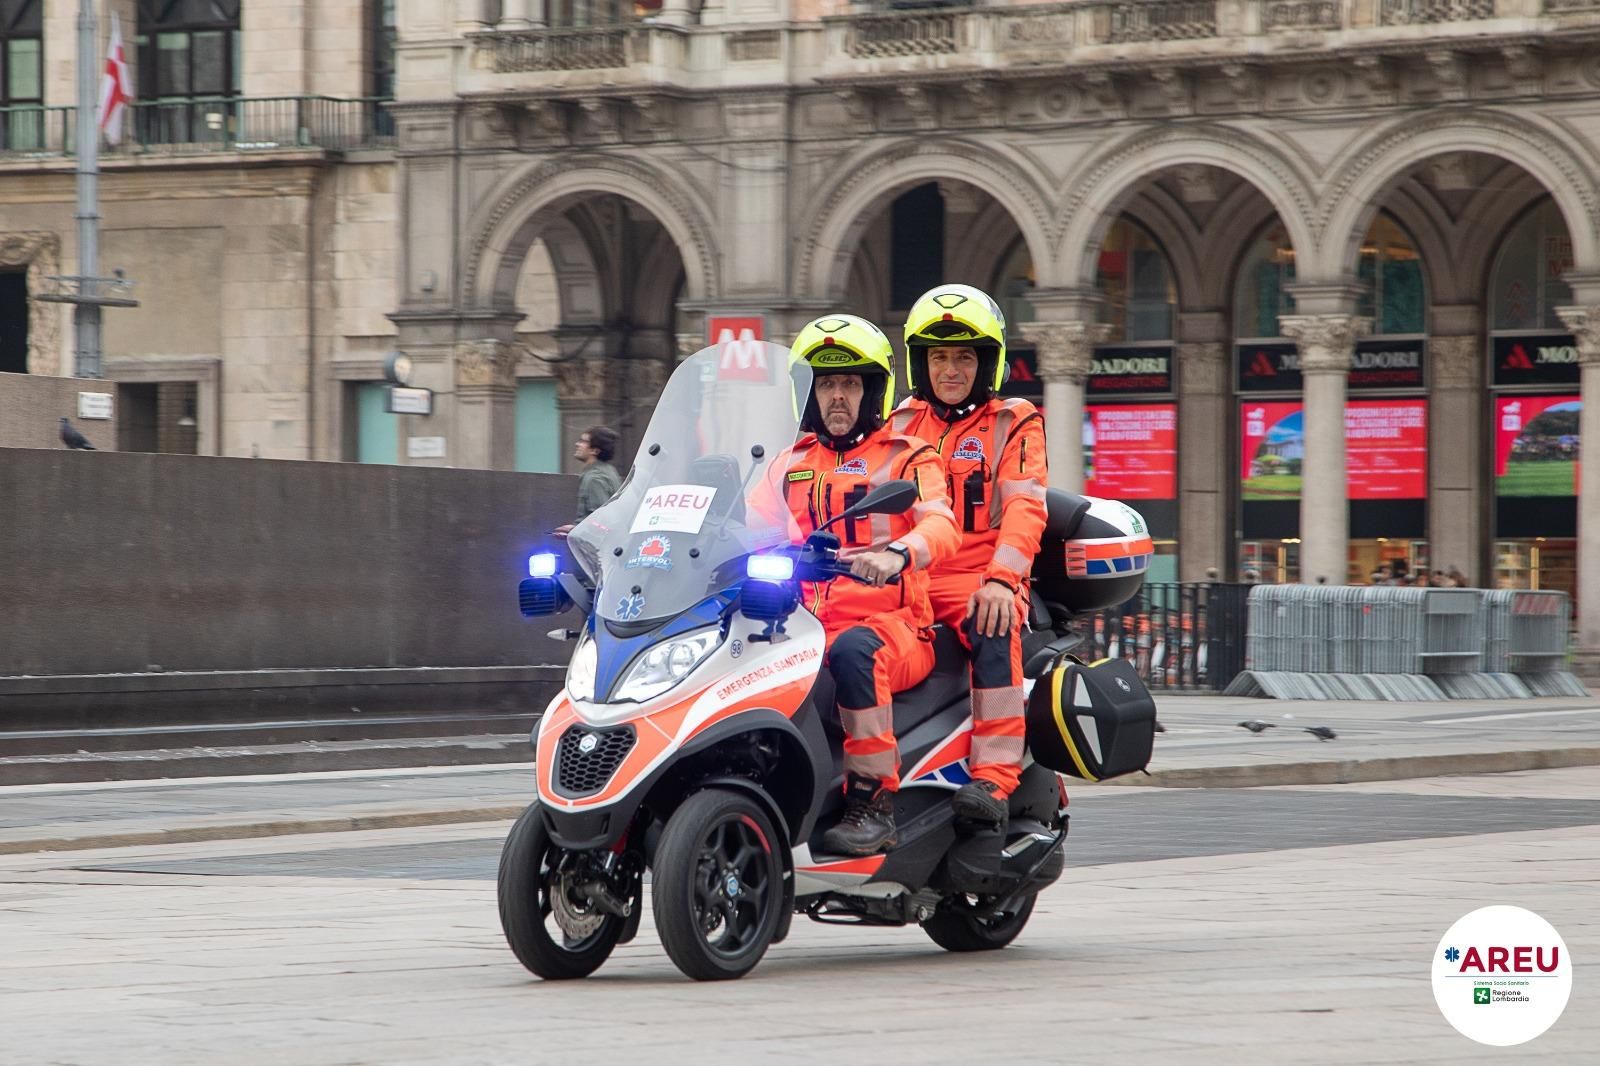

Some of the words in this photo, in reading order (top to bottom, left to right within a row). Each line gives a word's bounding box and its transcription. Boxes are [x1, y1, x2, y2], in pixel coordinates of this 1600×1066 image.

[822, 355, 848, 363] HJC
[1087, 358, 1168, 374] DADORI
[649, 494, 709, 510] AREU
[628, 555, 669, 565] INTERVOL
[716, 665, 774, 700] EMERGENZA
[773, 647, 819, 673] SANITARIA
